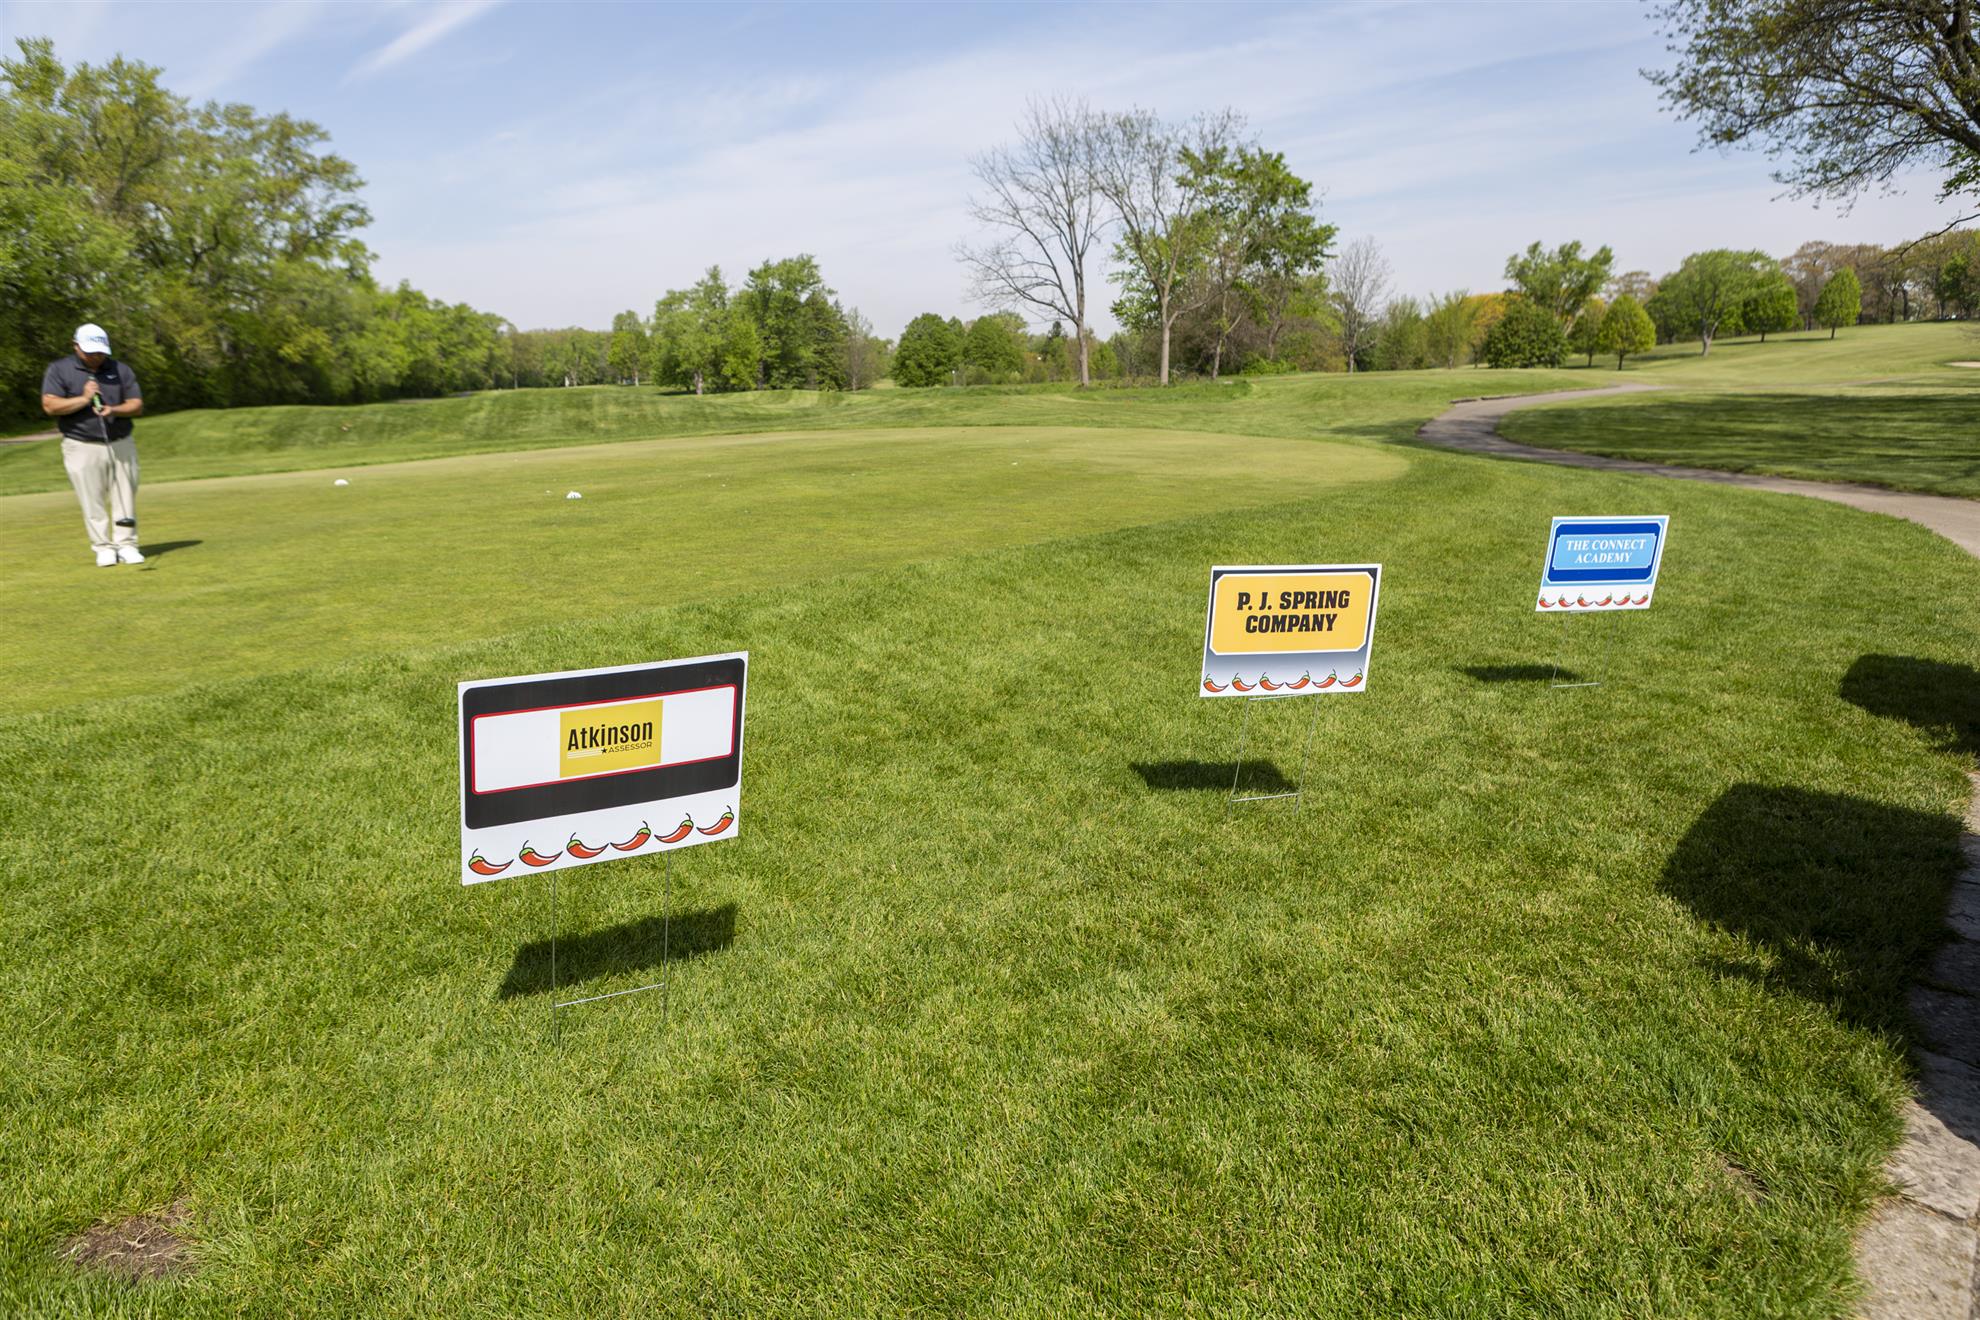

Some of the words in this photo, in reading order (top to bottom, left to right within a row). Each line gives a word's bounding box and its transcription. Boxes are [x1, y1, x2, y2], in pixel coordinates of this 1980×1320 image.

[1567, 540, 1590, 550] THE
[1592, 539, 1646, 551] CONNECT
[1575, 552, 1632, 563] ACADEMY
[1237, 592, 1253, 611] P.
[1259, 592, 1272, 610] J.
[1279, 590, 1350, 610] SPRING
[1245, 613, 1338, 633] COMPANY
[568, 721, 652, 750] Atkinson
[609, 742, 652, 752] ASSESSOR
